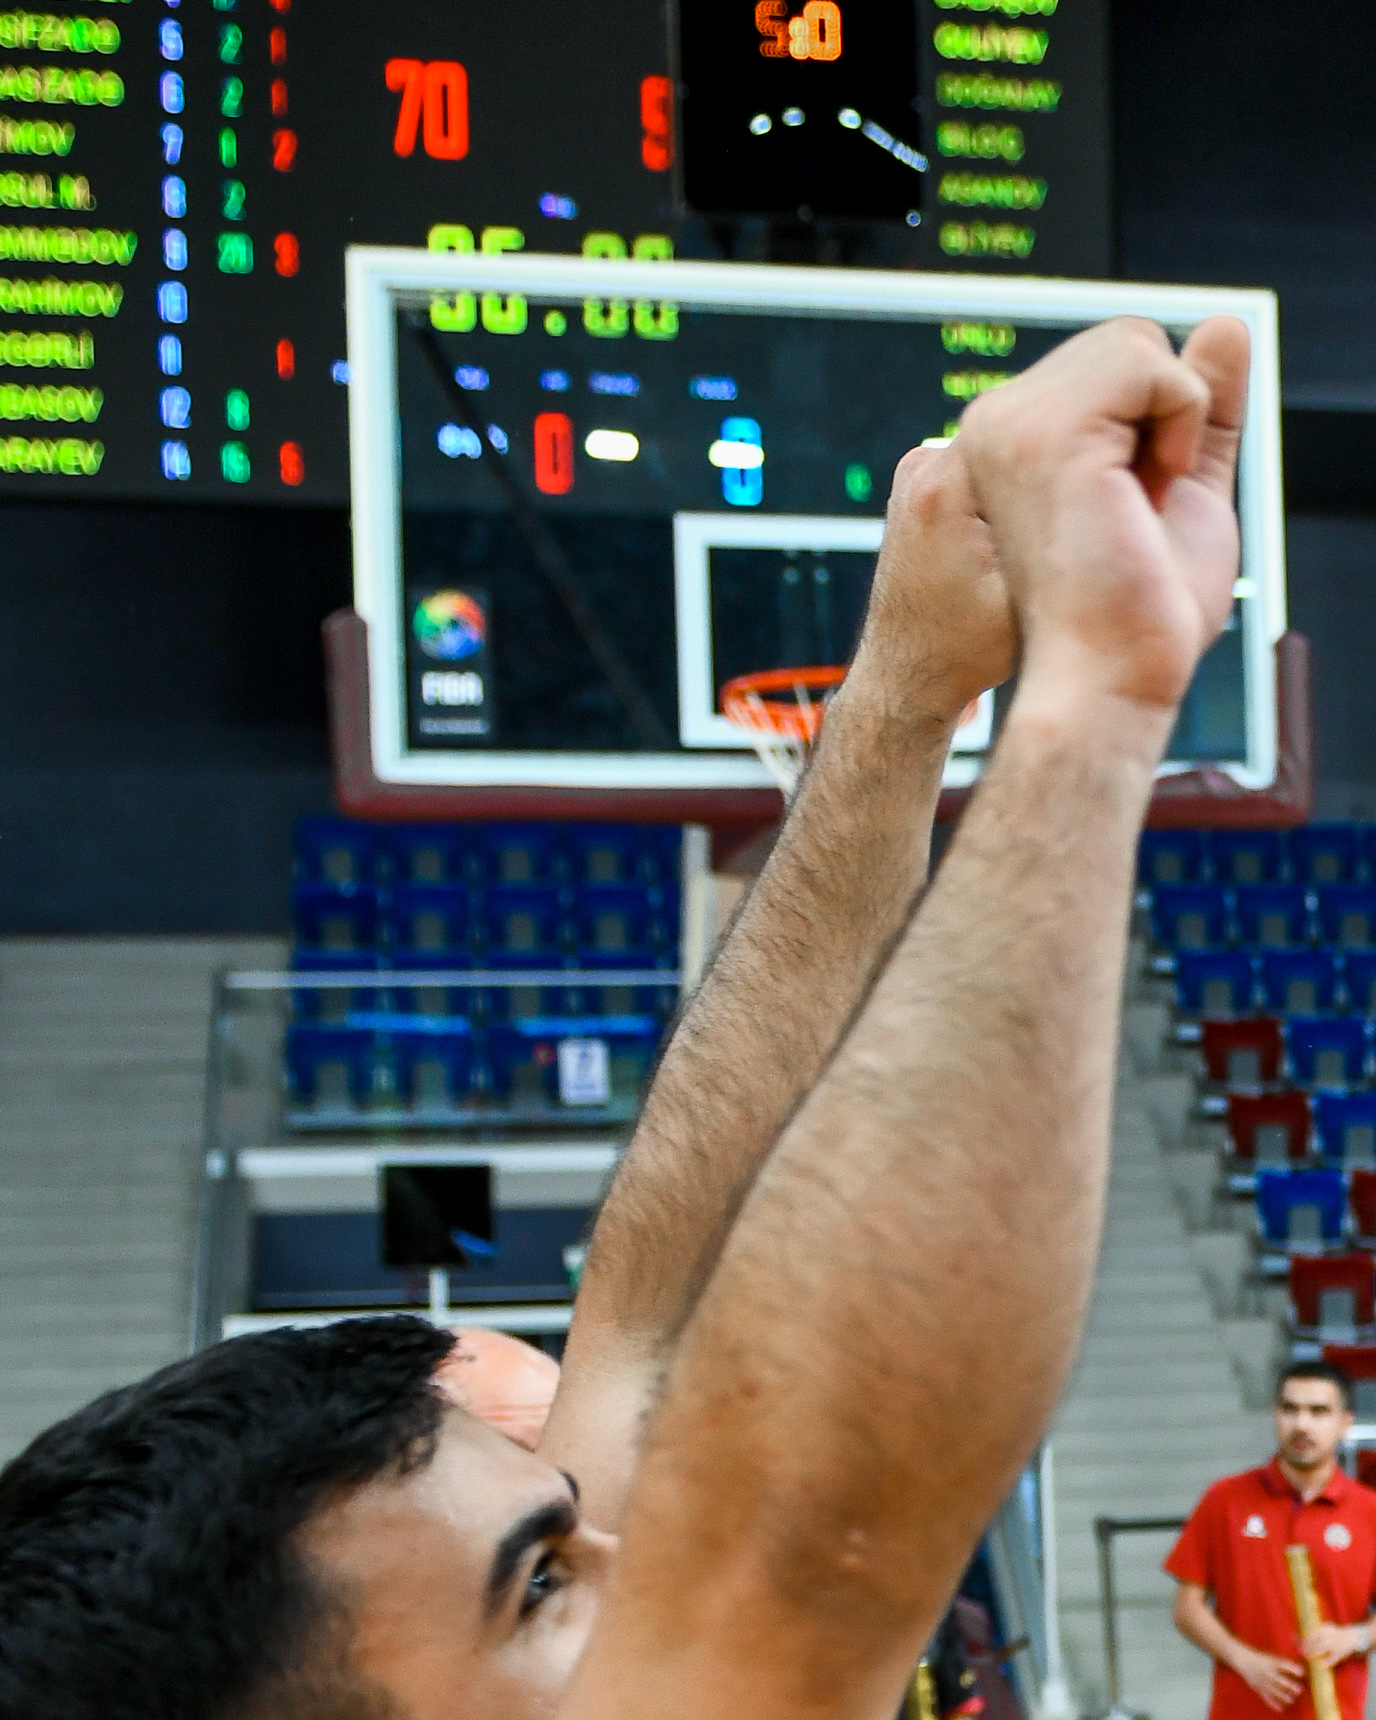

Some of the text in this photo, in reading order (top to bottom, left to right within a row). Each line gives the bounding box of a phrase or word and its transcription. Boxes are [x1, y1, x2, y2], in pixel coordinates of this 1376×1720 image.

[219, 23, 243, 64] 2
[220, 76, 244, 117] 2
[385, 58, 470, 160] 70
[223, 179, 246, 220] 2
